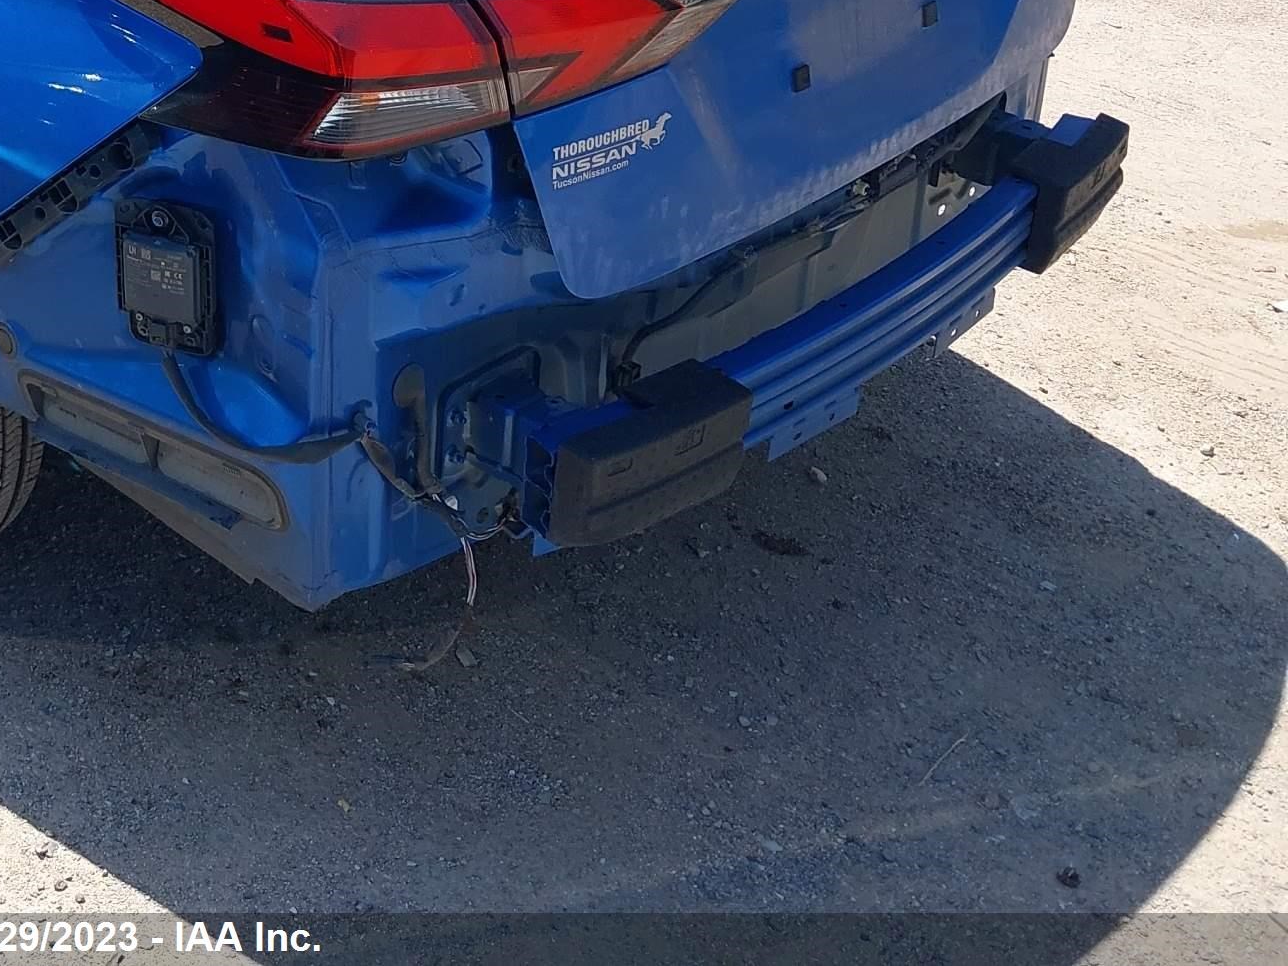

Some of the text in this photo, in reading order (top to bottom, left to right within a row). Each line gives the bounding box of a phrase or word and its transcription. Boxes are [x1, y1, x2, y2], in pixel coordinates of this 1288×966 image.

[552, 119, 650, 161] THOROUGHBRED
[552, 141, 637, 180] NISSAN
[552, 159, 629, 190] TucsonNissan.com
